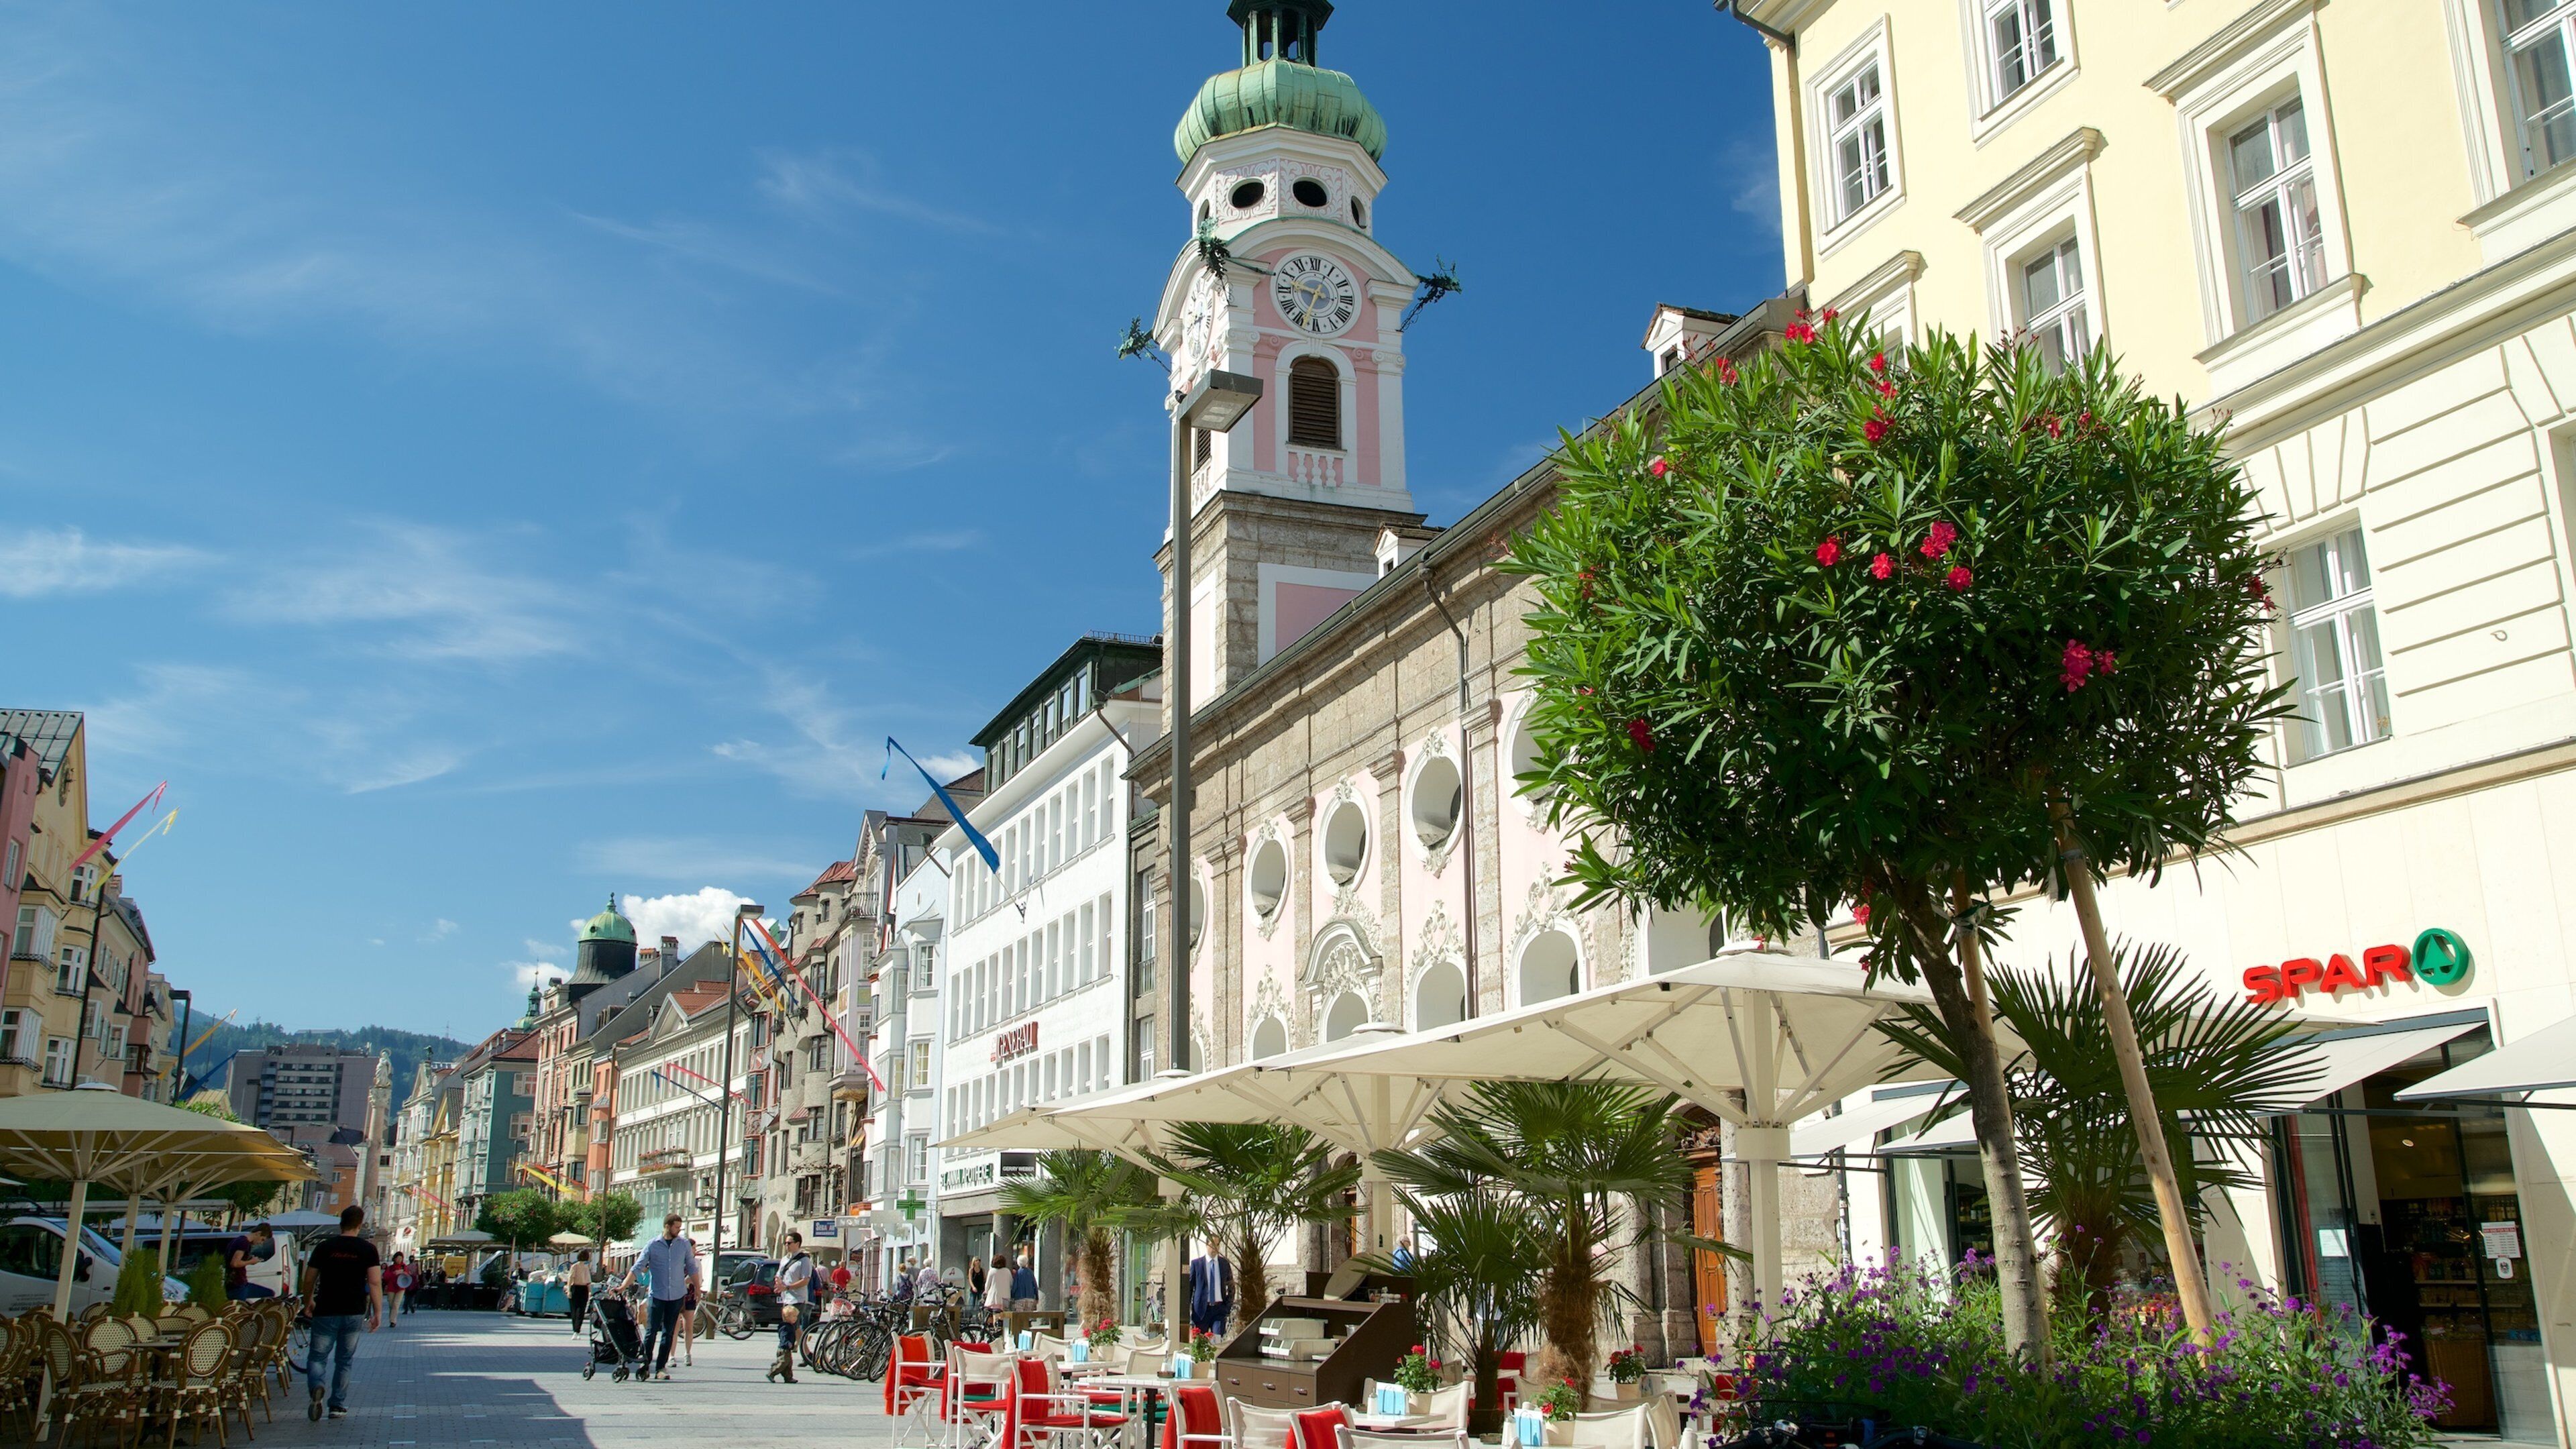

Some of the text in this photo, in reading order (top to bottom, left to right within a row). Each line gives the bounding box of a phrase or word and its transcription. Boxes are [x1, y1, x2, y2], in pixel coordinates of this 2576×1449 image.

[1293, 259, 1305, 273] XI
[1309, 257, 1321, 271] XII
[1281, 268, 1295, 280] X
[1327, 266, 1336, 277] I
[1277, 283, 1291, 294] IX
[1336, 279, 1349, 288] II
[1281, 299, 1297, 315] VIII
[1340, 295, 1353, 307] III
[1311, 318, 1321, 332] VI
[1328, 317, 1338, 330] V
[2243, 944, 2413, 1004] SPAR
[998, 1022, 1038, 1058] GENERALI
